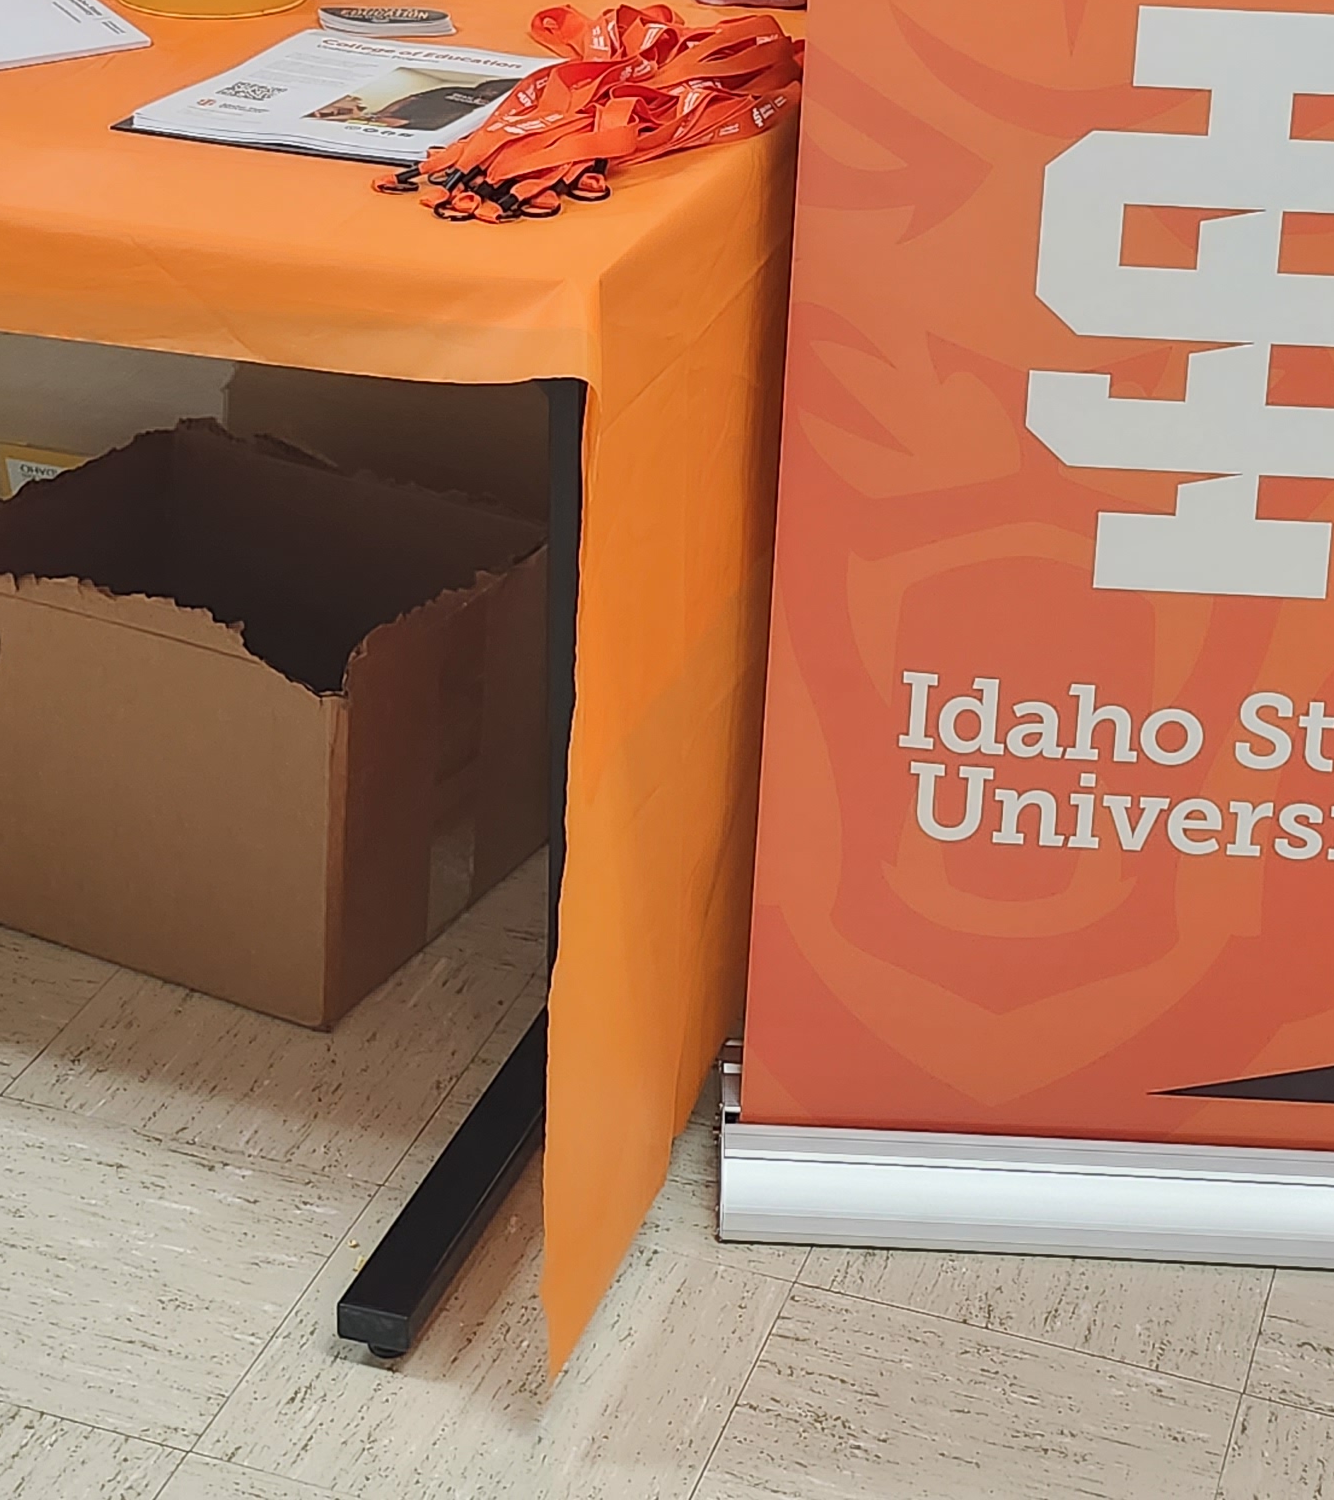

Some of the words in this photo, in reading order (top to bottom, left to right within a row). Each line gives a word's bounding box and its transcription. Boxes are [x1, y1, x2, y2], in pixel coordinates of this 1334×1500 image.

[339, 7, 430, 20] EDUCATION
[321, 37, 397, 55] College
[398, 48, 422, 58] of
[426, 51, 524, 70] Education
[898, 669, 1205, 766] Idaho
